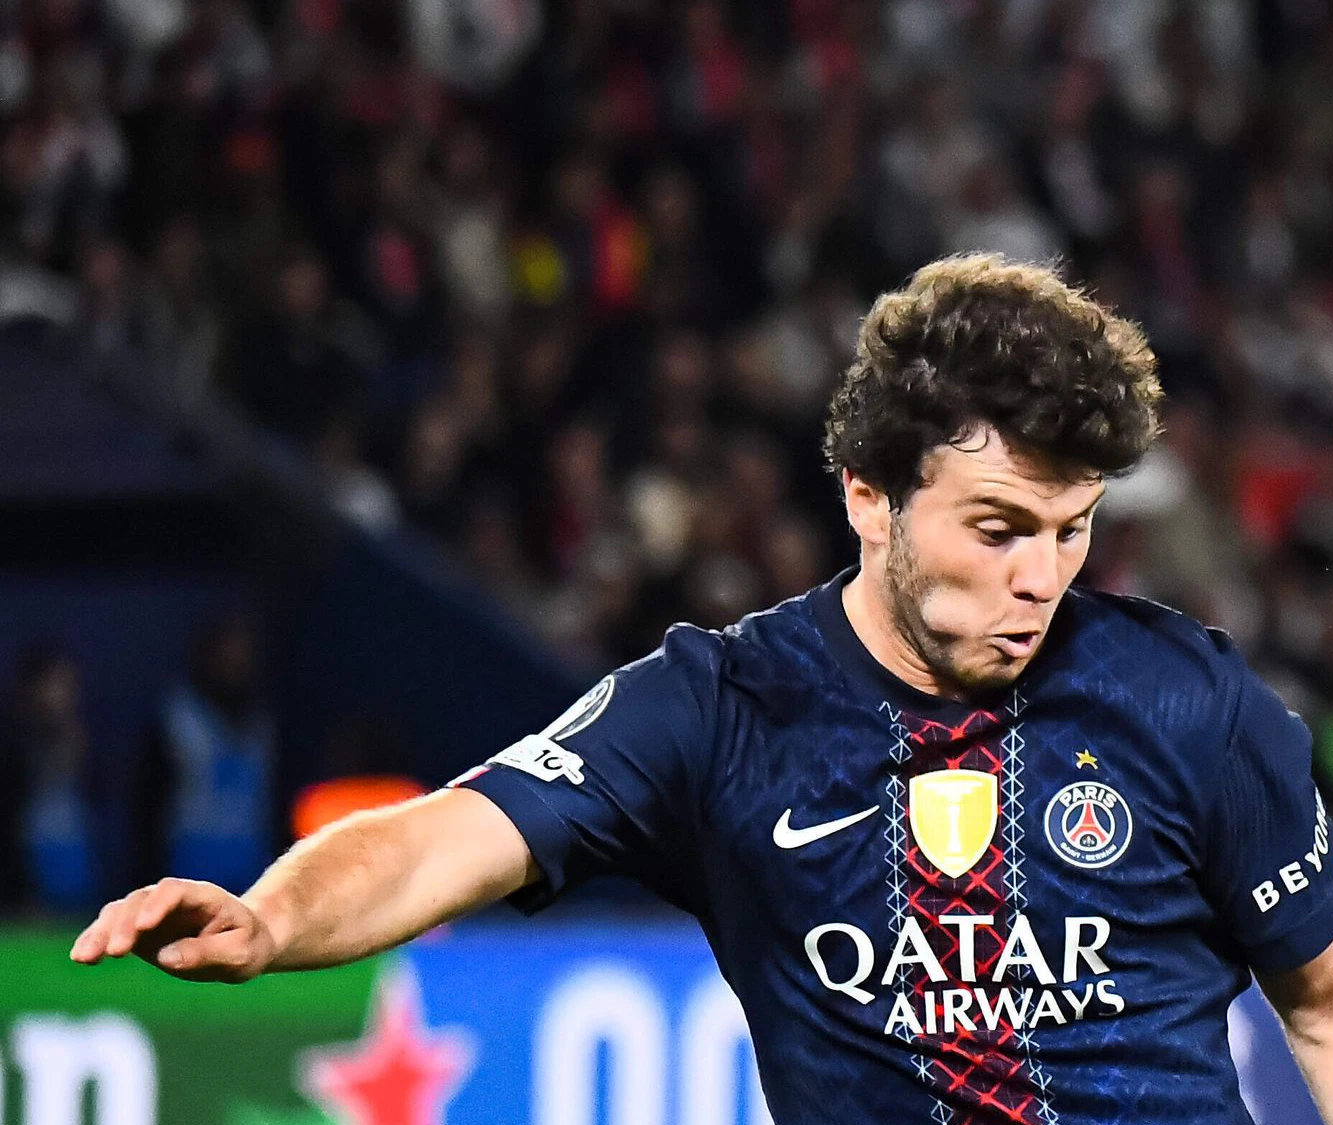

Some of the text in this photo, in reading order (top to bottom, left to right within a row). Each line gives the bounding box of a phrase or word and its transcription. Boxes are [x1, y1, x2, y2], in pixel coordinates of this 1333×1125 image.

[1059, 786, 1117, 808] PARIS
[1252, 786, 1329, 913] BEYON
[804, 914, 1111, 1005] QATAR
[884, 979, 1125, 1035] AIRWAYS
